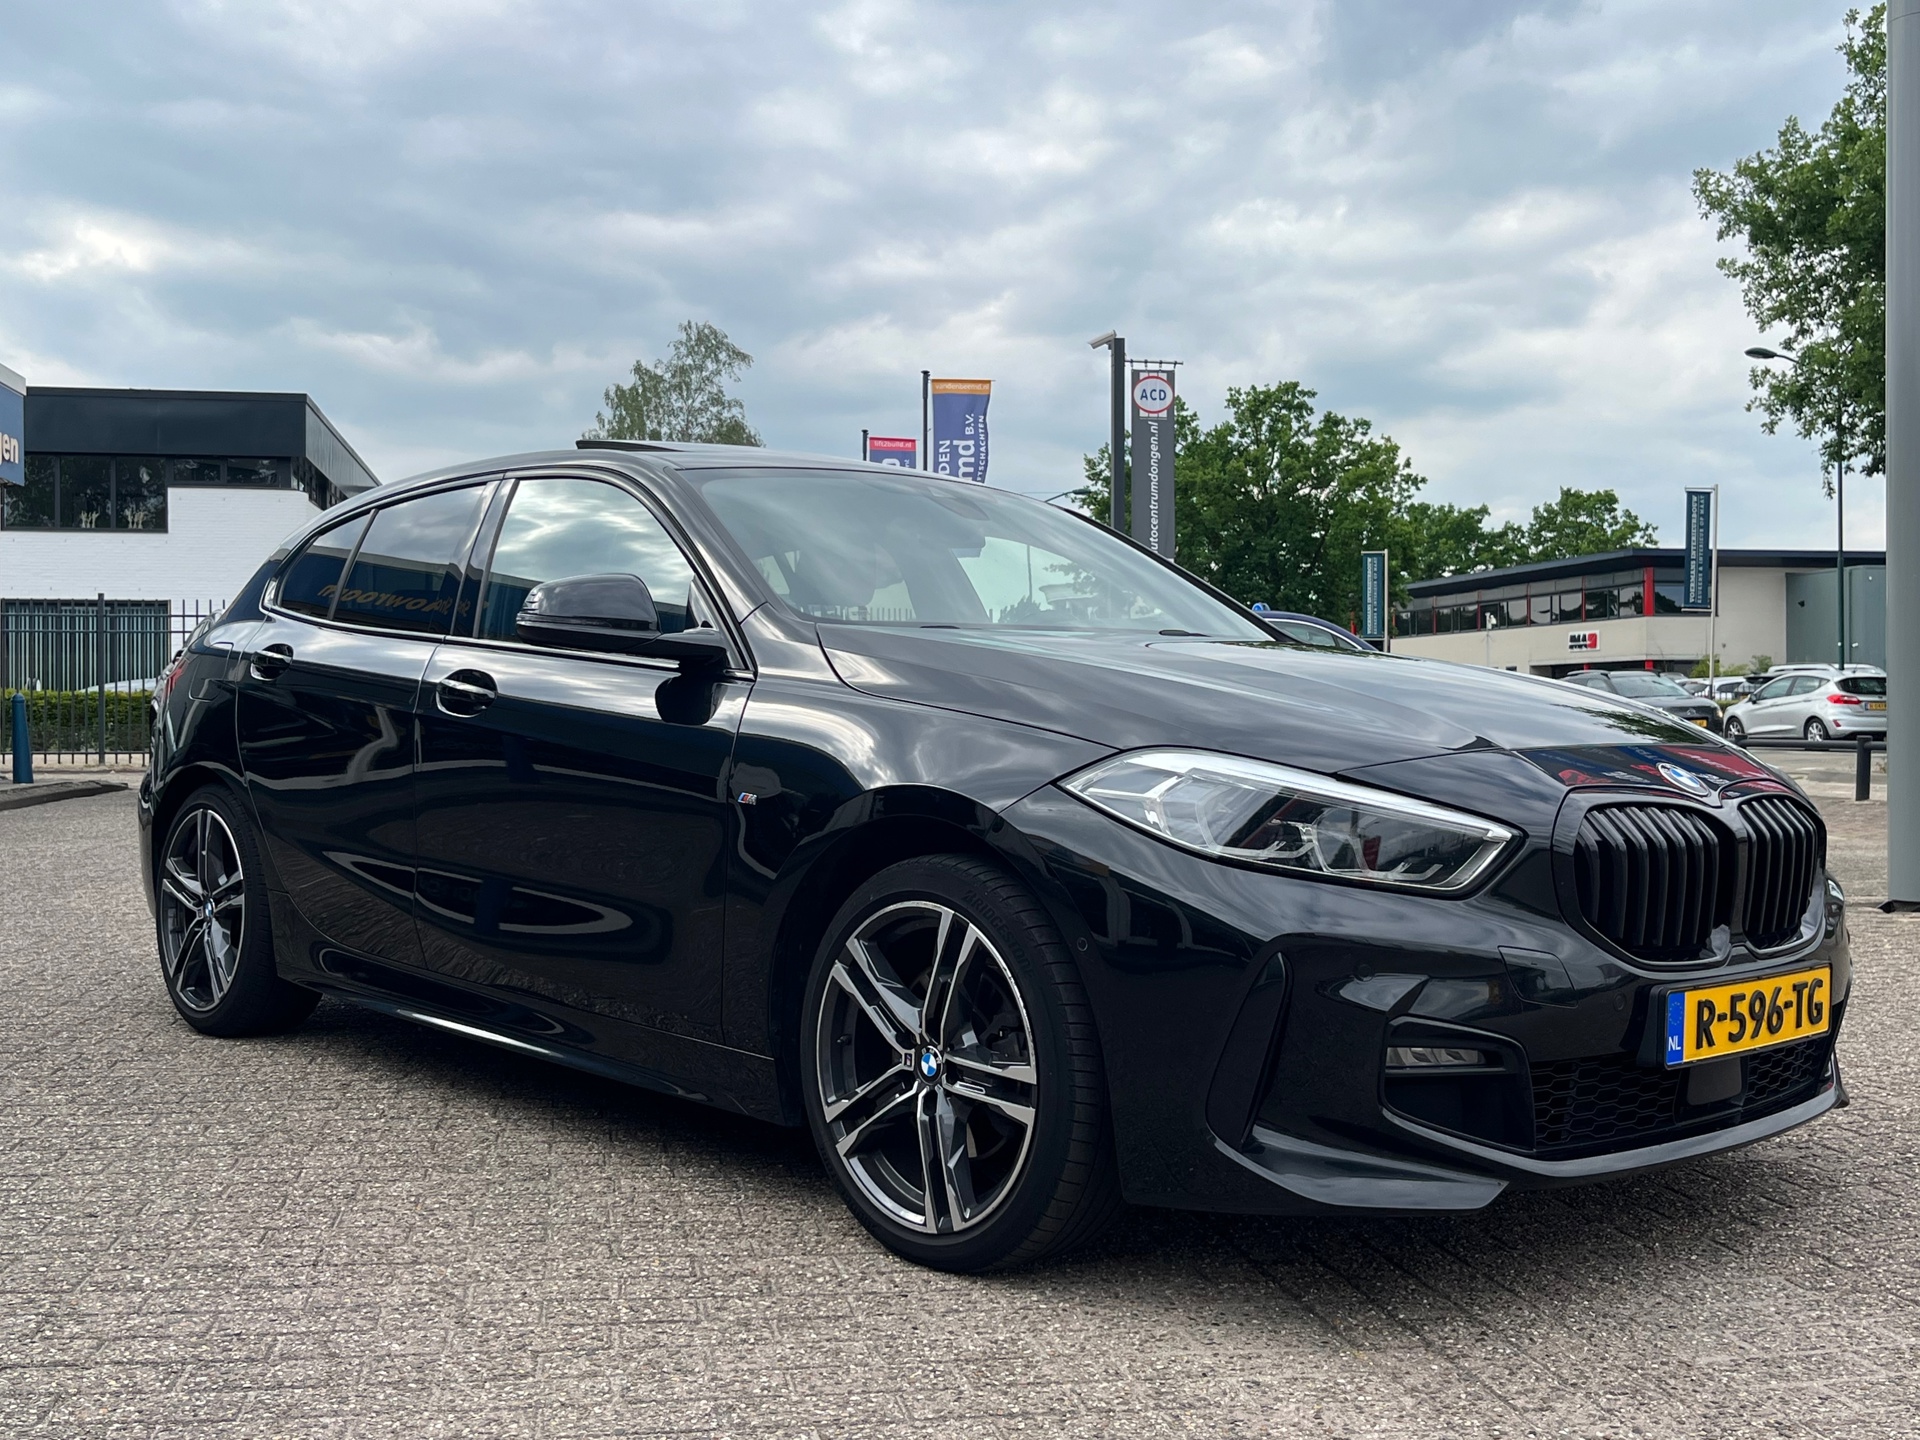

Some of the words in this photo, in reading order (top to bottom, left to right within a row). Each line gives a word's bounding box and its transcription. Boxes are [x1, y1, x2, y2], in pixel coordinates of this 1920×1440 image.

[1140, 388, 1167, 401] ACD
[964, 413, 975, 435] B.V.
[1147, 421, 1162, 553] utocentrumdongen.nl
[1695, 977, 1824, 1050] R-596-TG
[1668, 1035, 1682, 1052] NL
